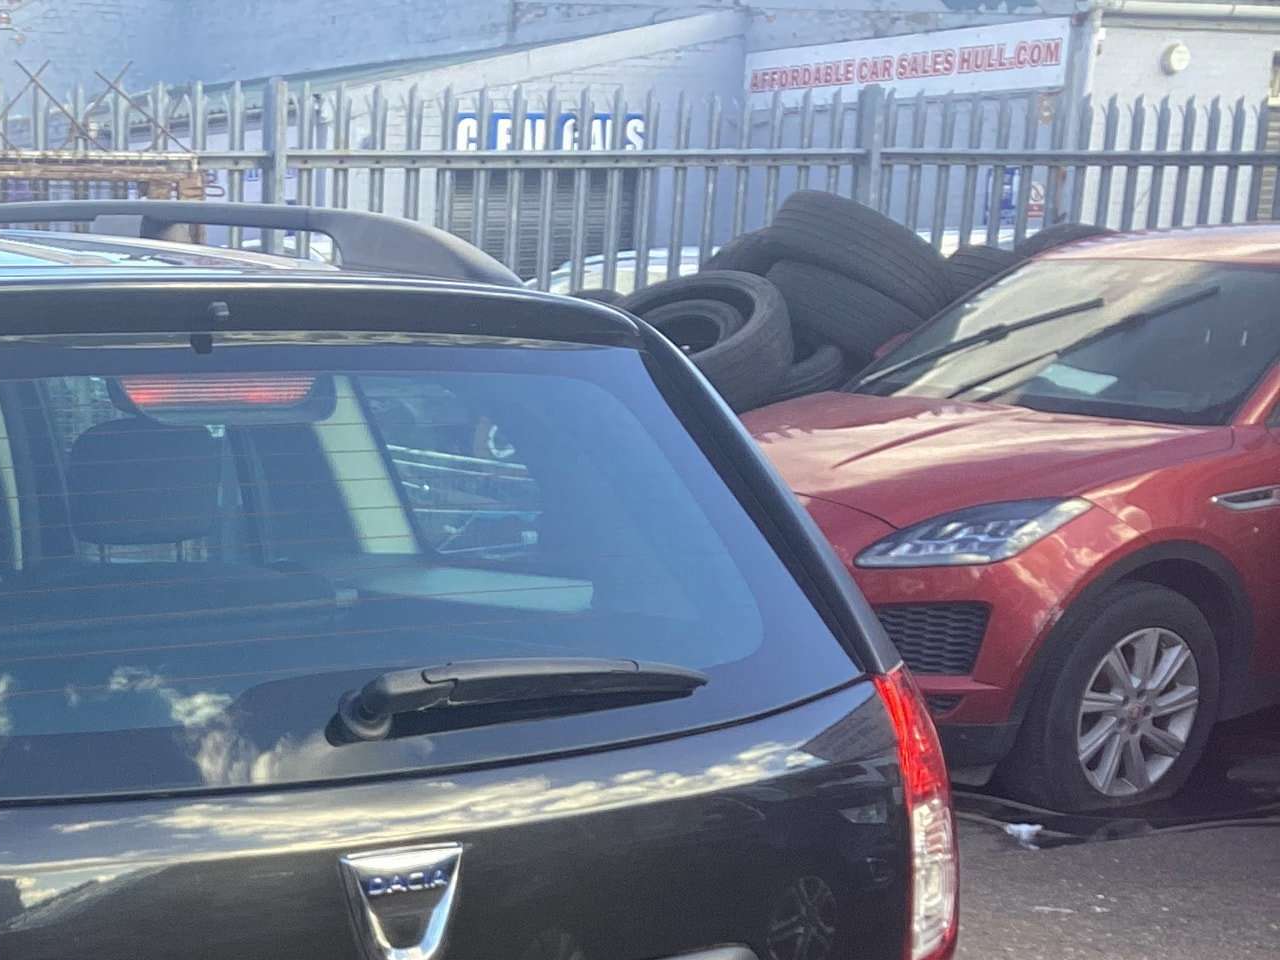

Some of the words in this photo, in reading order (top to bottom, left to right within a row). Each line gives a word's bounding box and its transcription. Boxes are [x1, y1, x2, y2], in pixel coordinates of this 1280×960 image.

[751, 59, 855, 92] AFFORDABLE
[856, 56, 893, 83] CAR
[896, 49, 956, 79] SALES
[957, 38, 1063, 73] HULL.COM
[368, 869, 448, 895] DACIA
